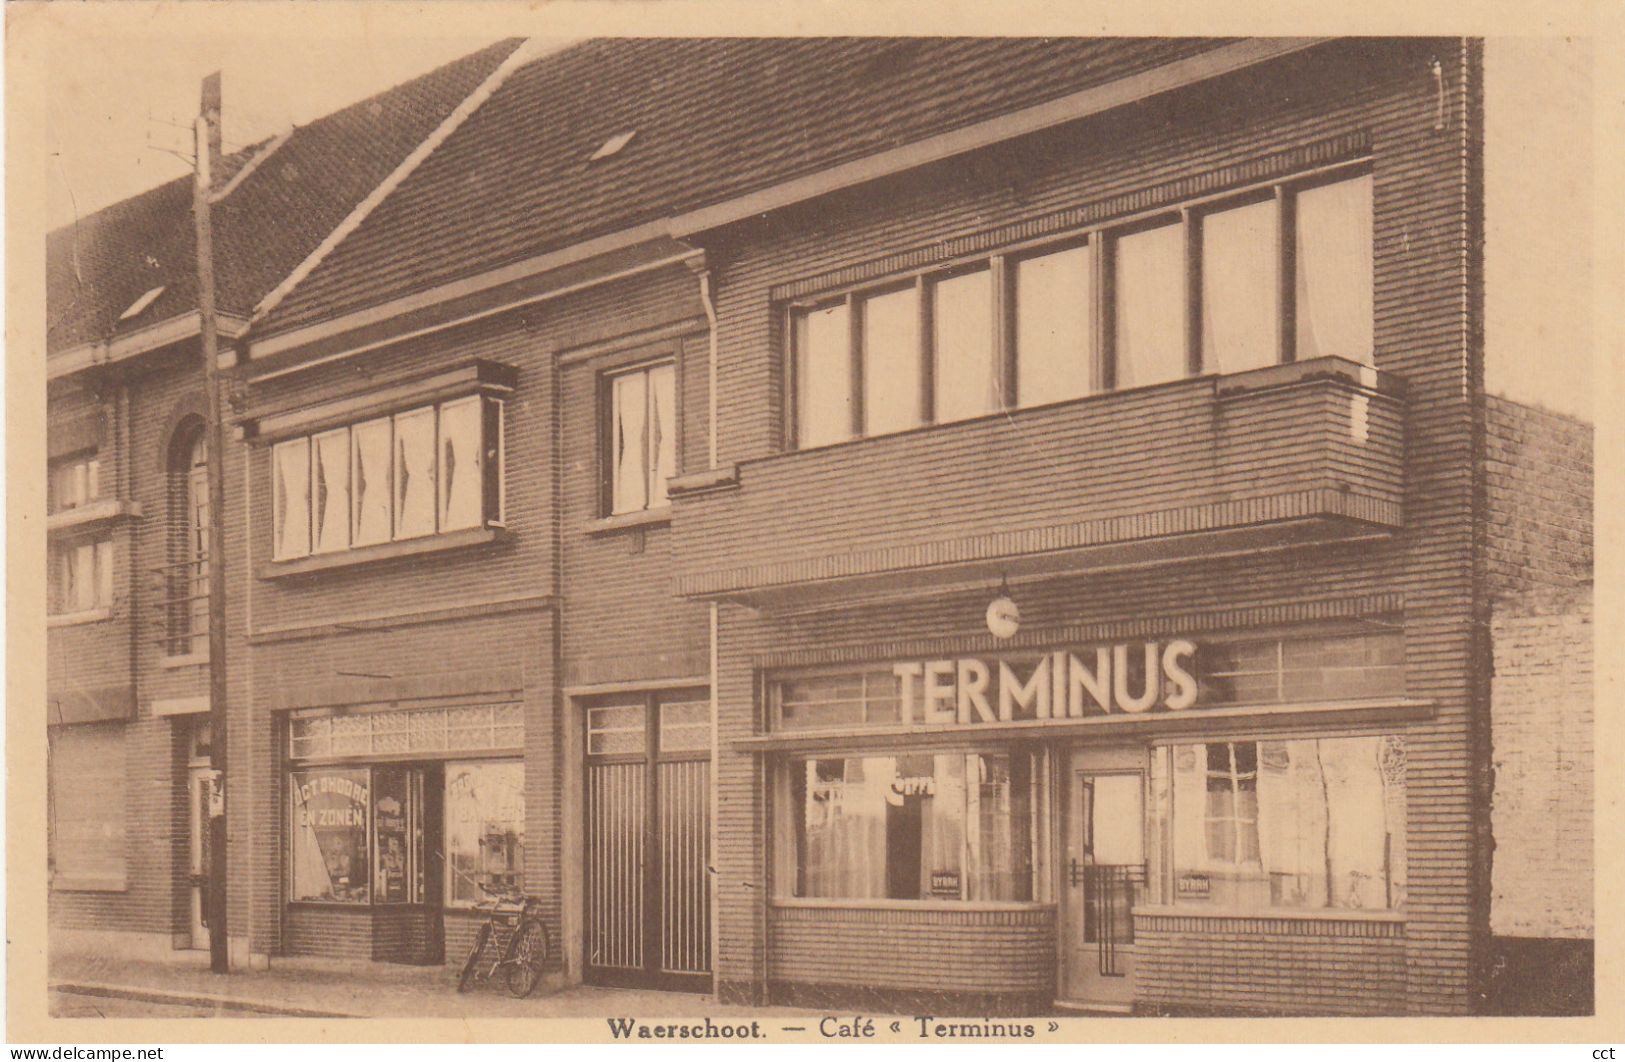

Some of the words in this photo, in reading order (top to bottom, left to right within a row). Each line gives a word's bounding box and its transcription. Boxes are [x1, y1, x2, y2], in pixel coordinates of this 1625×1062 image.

[894, 640, 1198, 725] TERMINUS
[300, 809, 316, 826] EN
[319, 809, 363, 827] ZONEN
